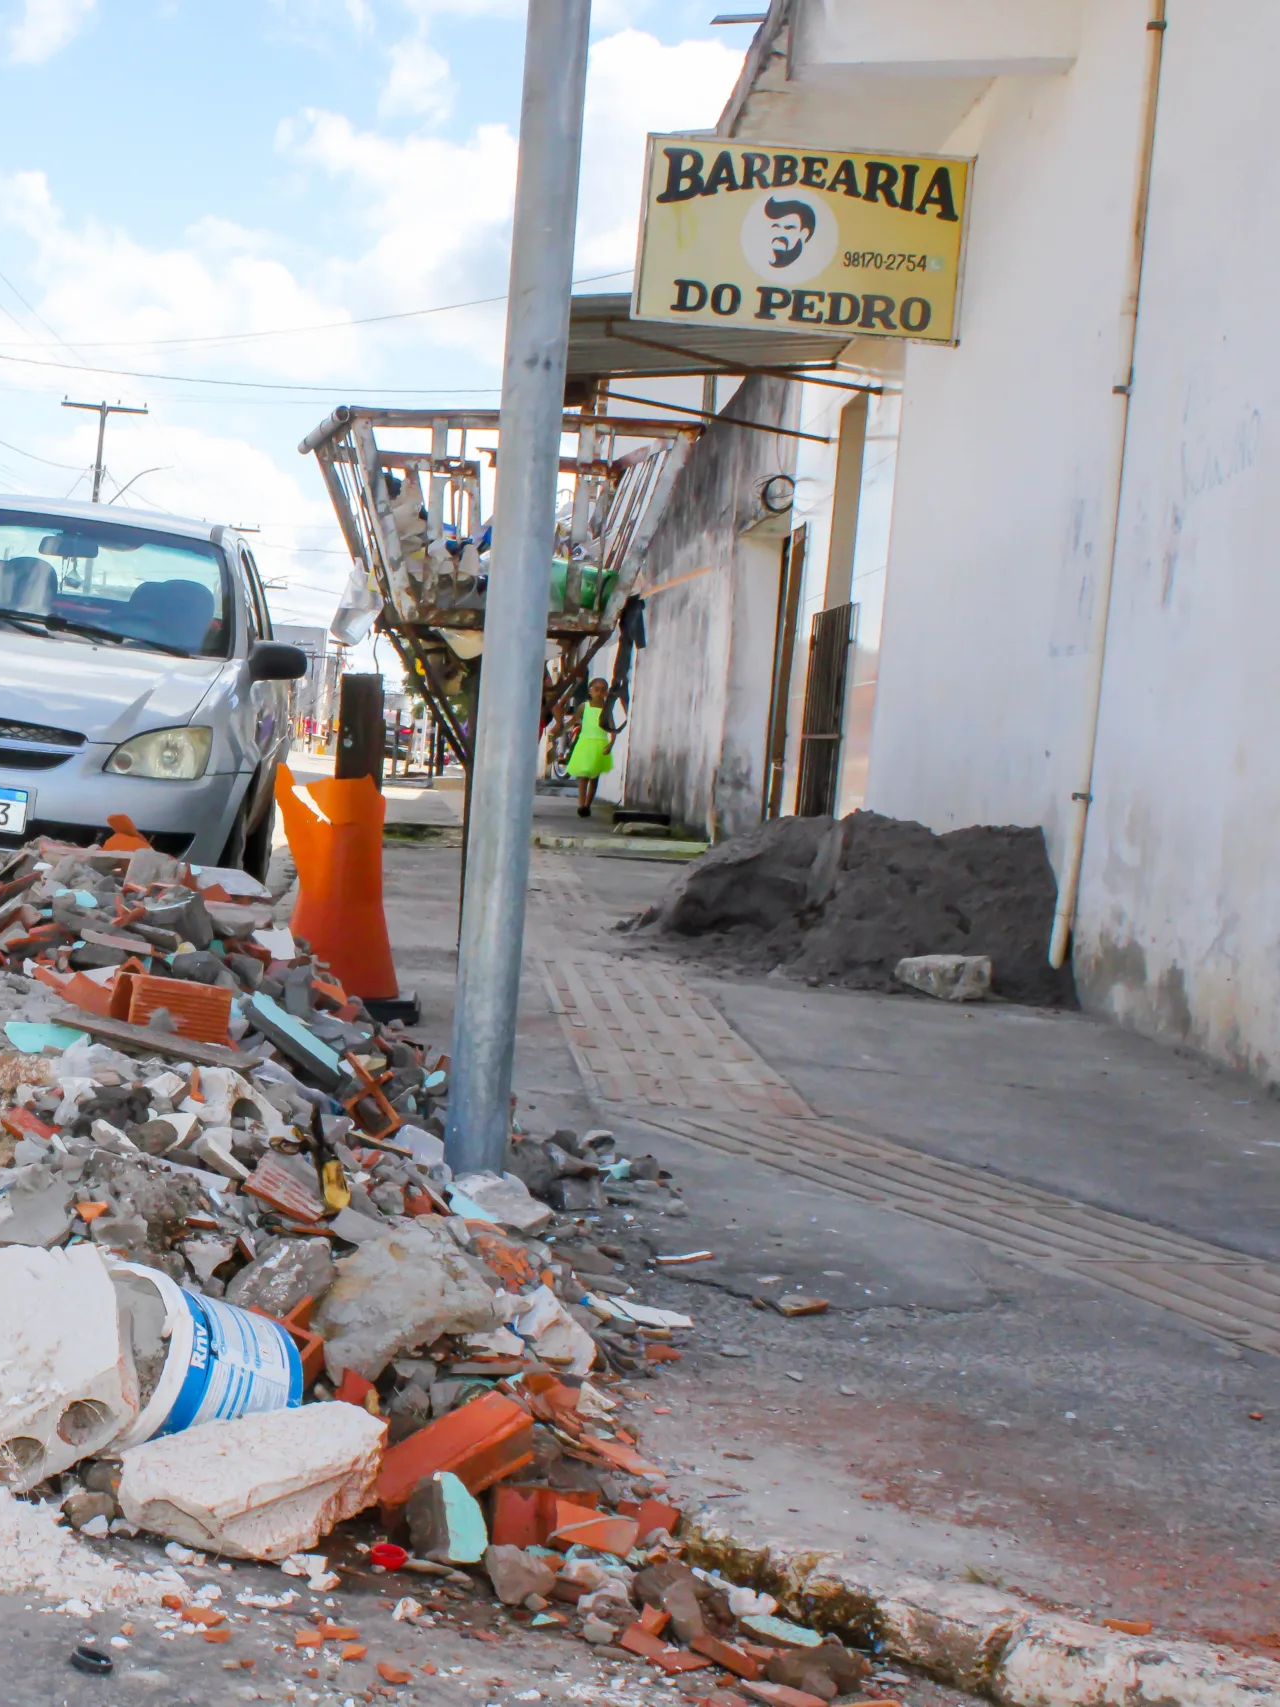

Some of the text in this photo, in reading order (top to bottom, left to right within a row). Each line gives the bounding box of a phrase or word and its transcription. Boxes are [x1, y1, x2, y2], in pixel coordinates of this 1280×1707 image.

[656, 147, 958, 221] BARBEARIA
[842, 251, 927, 272] 98170-2754
[670, 279, 932, 332] DO PEDRO
